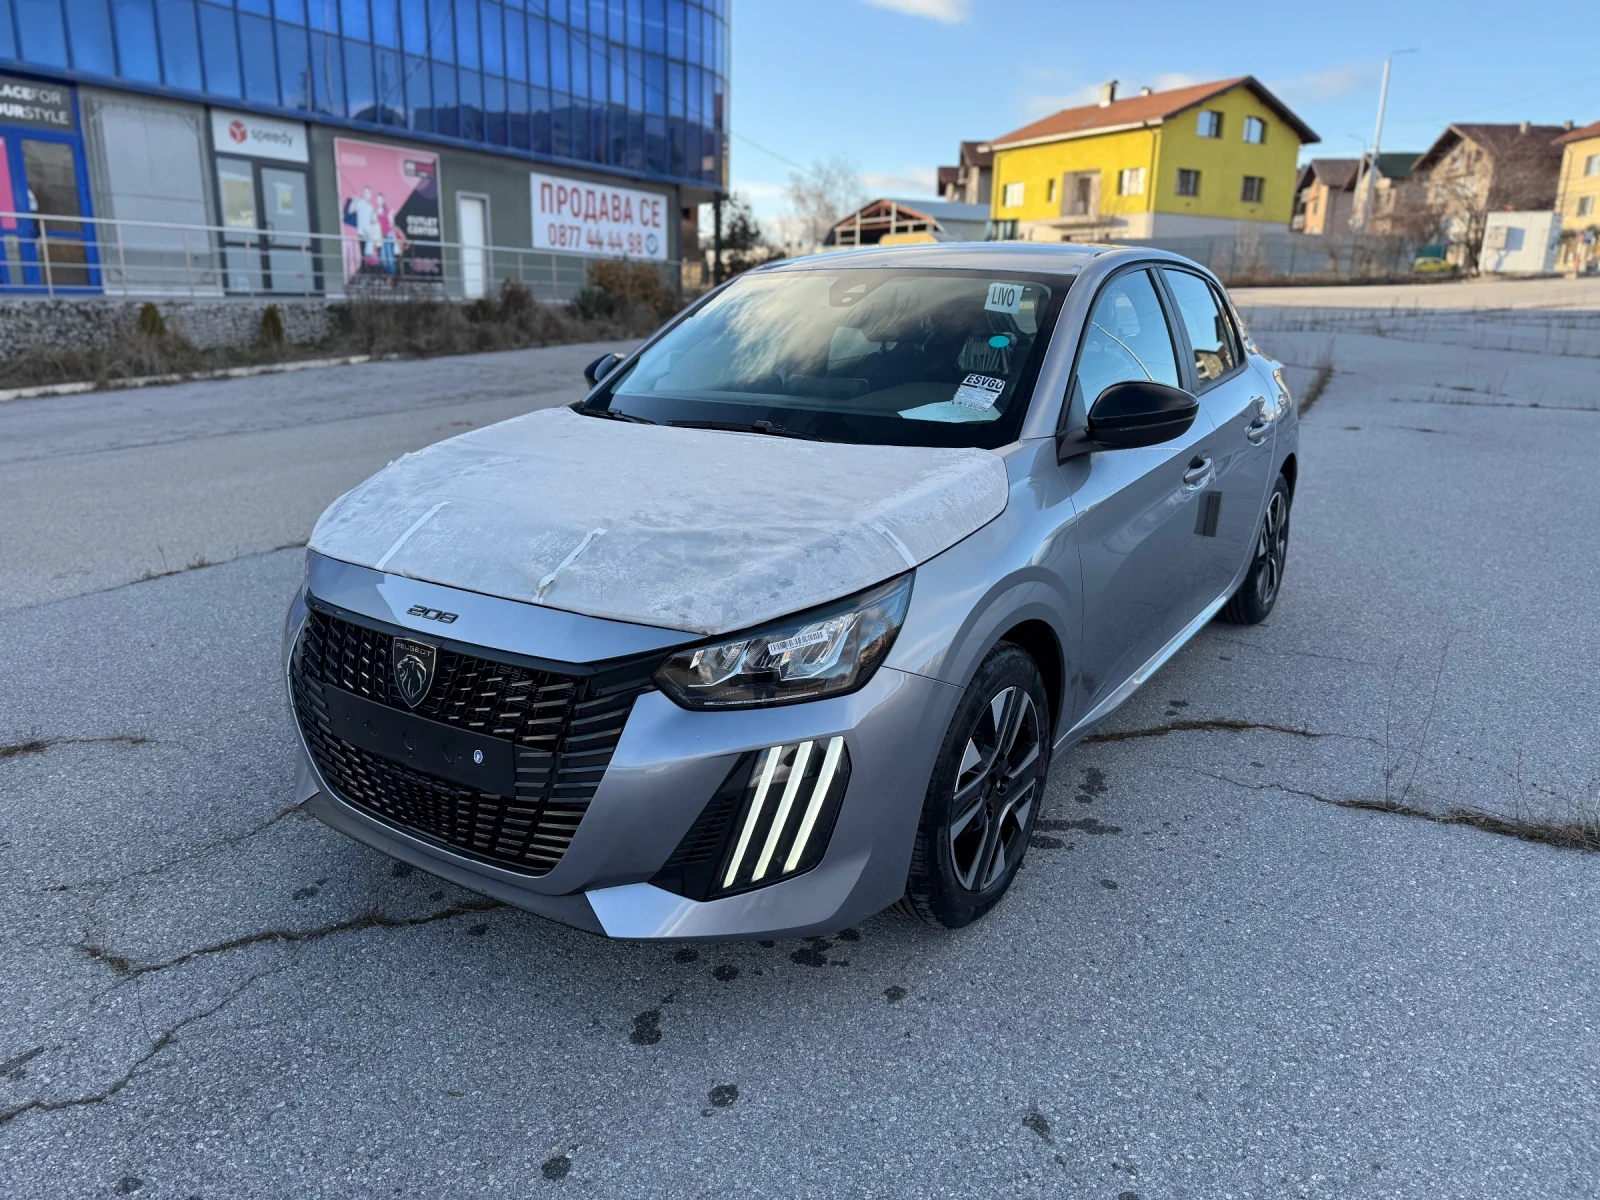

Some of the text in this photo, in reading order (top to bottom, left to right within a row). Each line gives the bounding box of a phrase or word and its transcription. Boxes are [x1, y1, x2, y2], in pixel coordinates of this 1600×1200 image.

[251, 129, 294, 148] speedy
[541, 182, 661, 228] ПРОДАВА СЕ
[548, 223, 581, 248] 0877
[586, 229, 604, 251] 44
[607, 231, 623, 251] 44
[991, 286, 1015, 308] LIVO
[406, 604, 459, 624] 208
[396, 642, 432, 657] PEUGEOT
